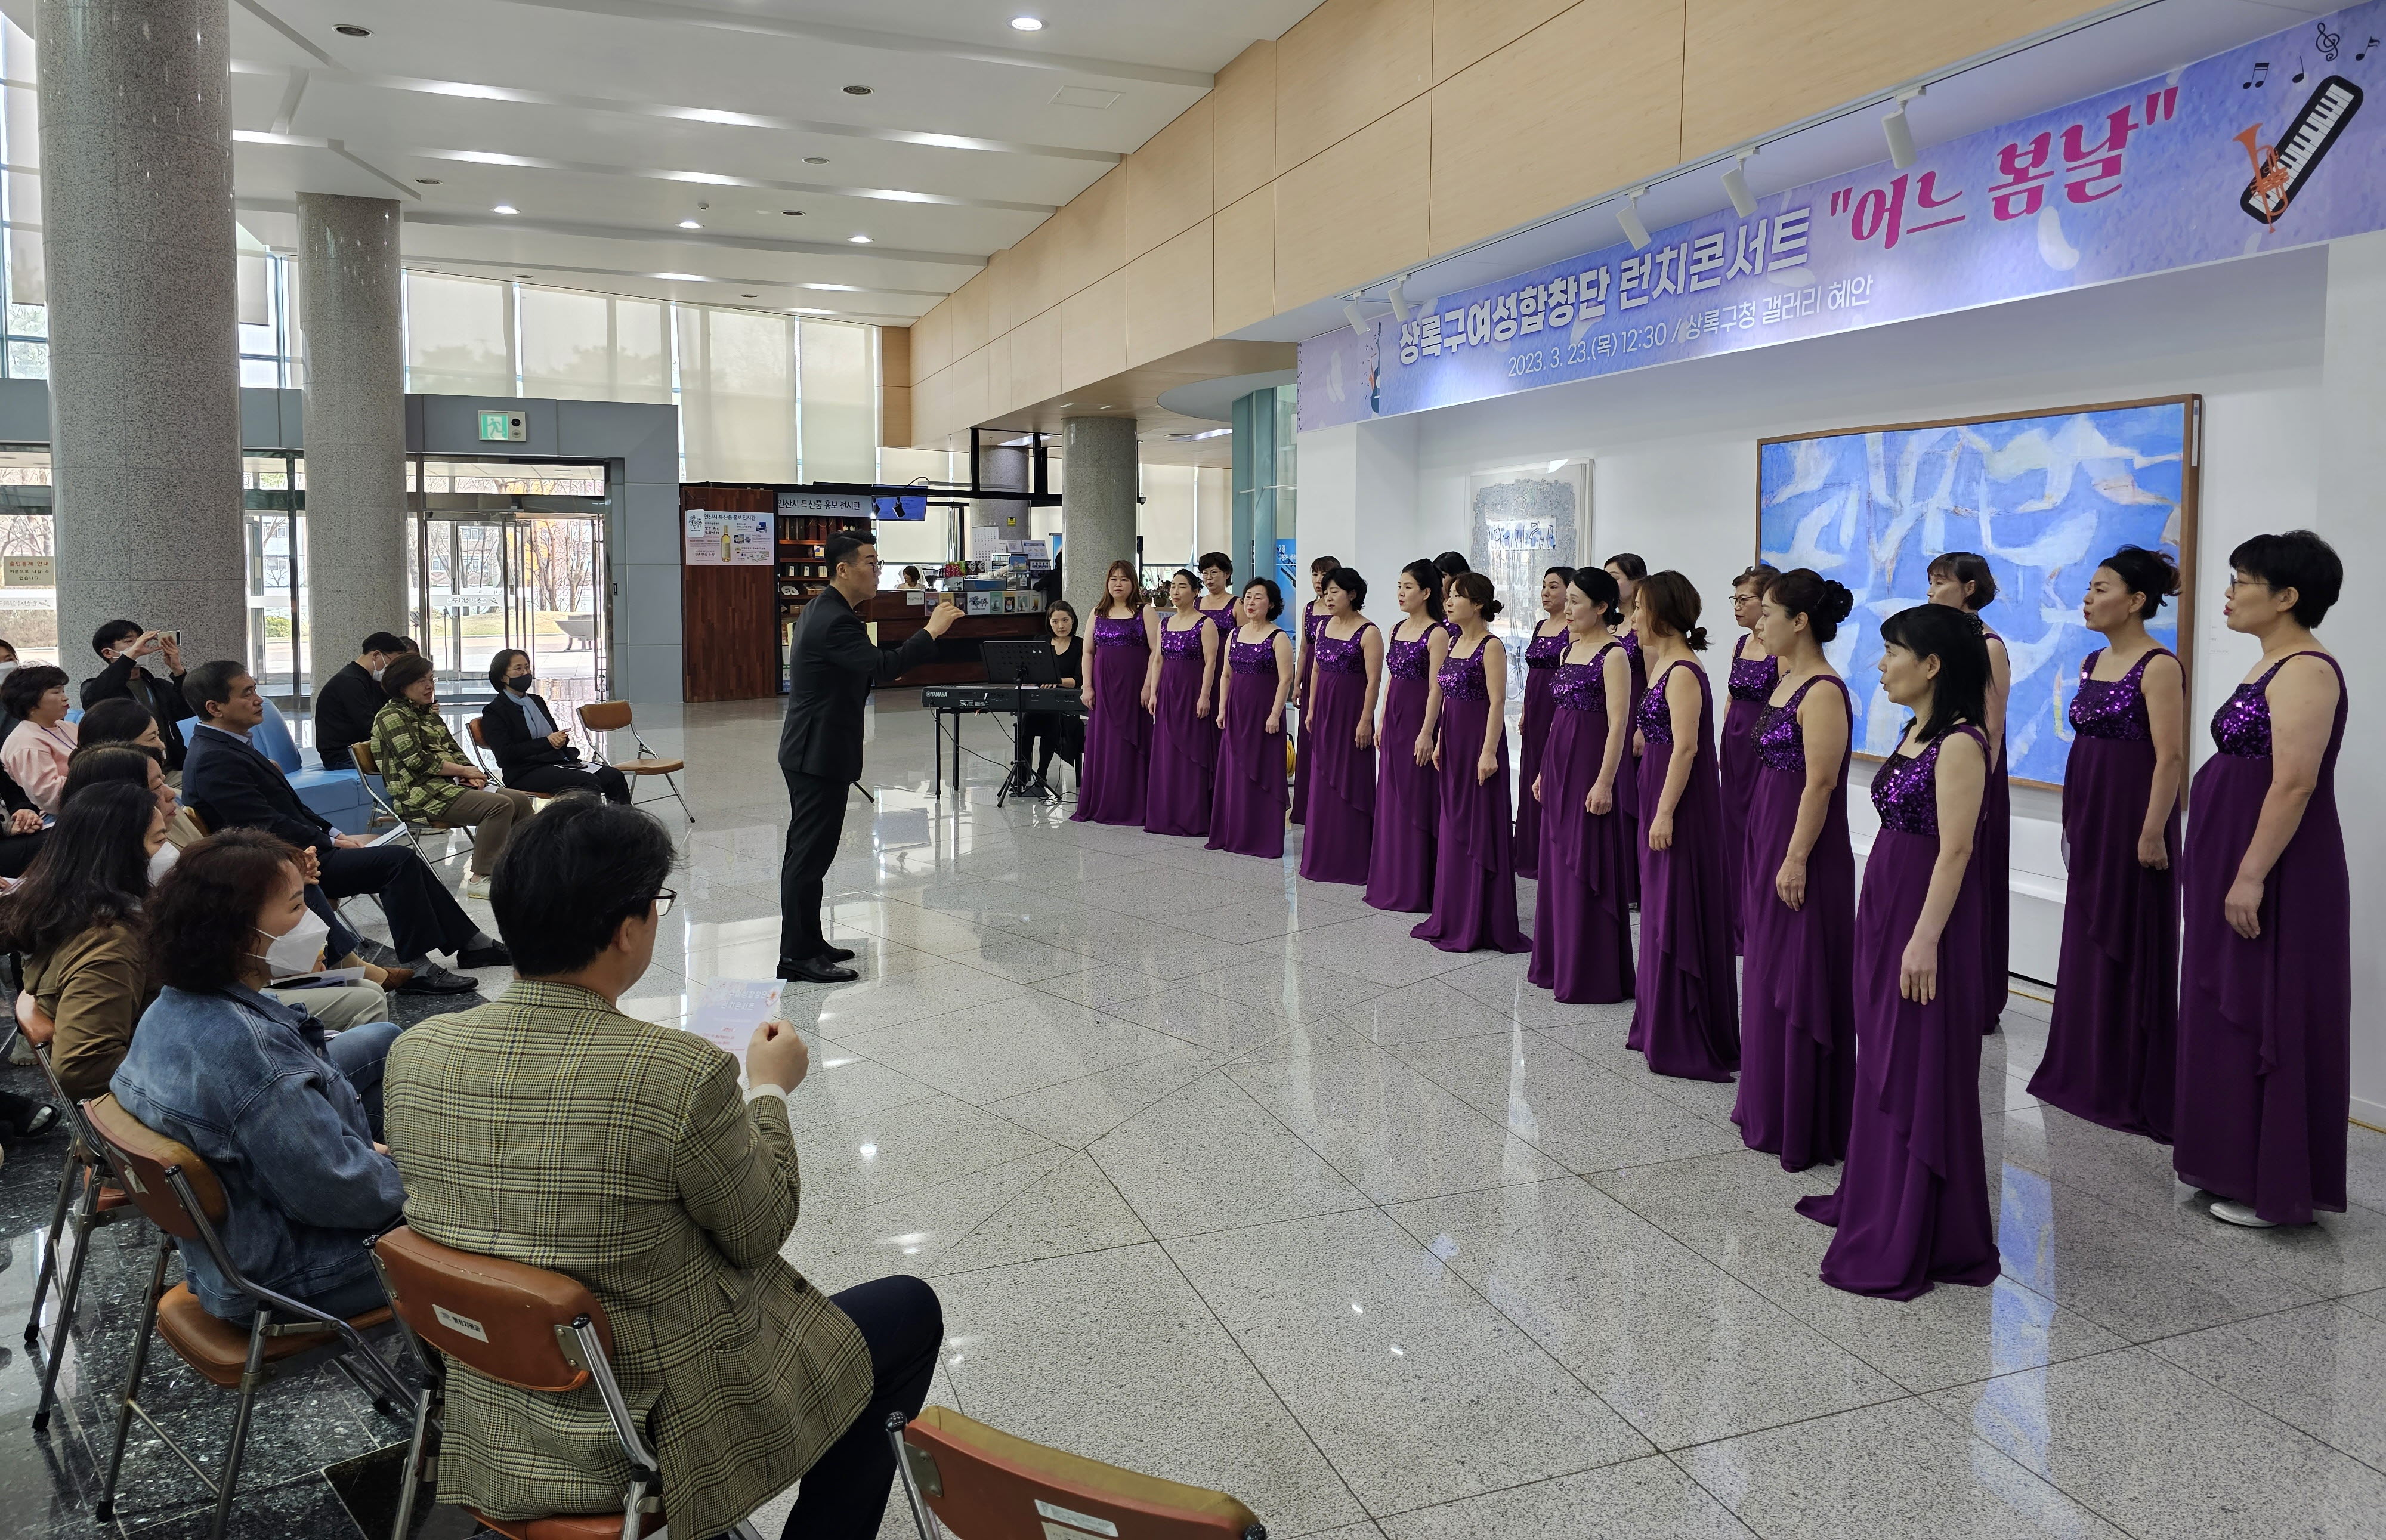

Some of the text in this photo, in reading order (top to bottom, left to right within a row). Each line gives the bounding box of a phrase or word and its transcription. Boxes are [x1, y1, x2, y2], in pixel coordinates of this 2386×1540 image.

[1399, 86, 2179, 364] 상록구여성합창단 런치콘서트 "어느 봄날"
[1508, 350, 1546, 378] 2023.
[1550, 347, 1563, 369] 3.
[1622, 322, 1667, 353] 12:30
[1686, 300, 1756, 341] 상록구청
[1762, 286, 1822, 326] 갤러리
[1827, 274, 1874, 310] 혜안
[777, 499, 860, 511] 안산시 특산품 홍보 전시관
